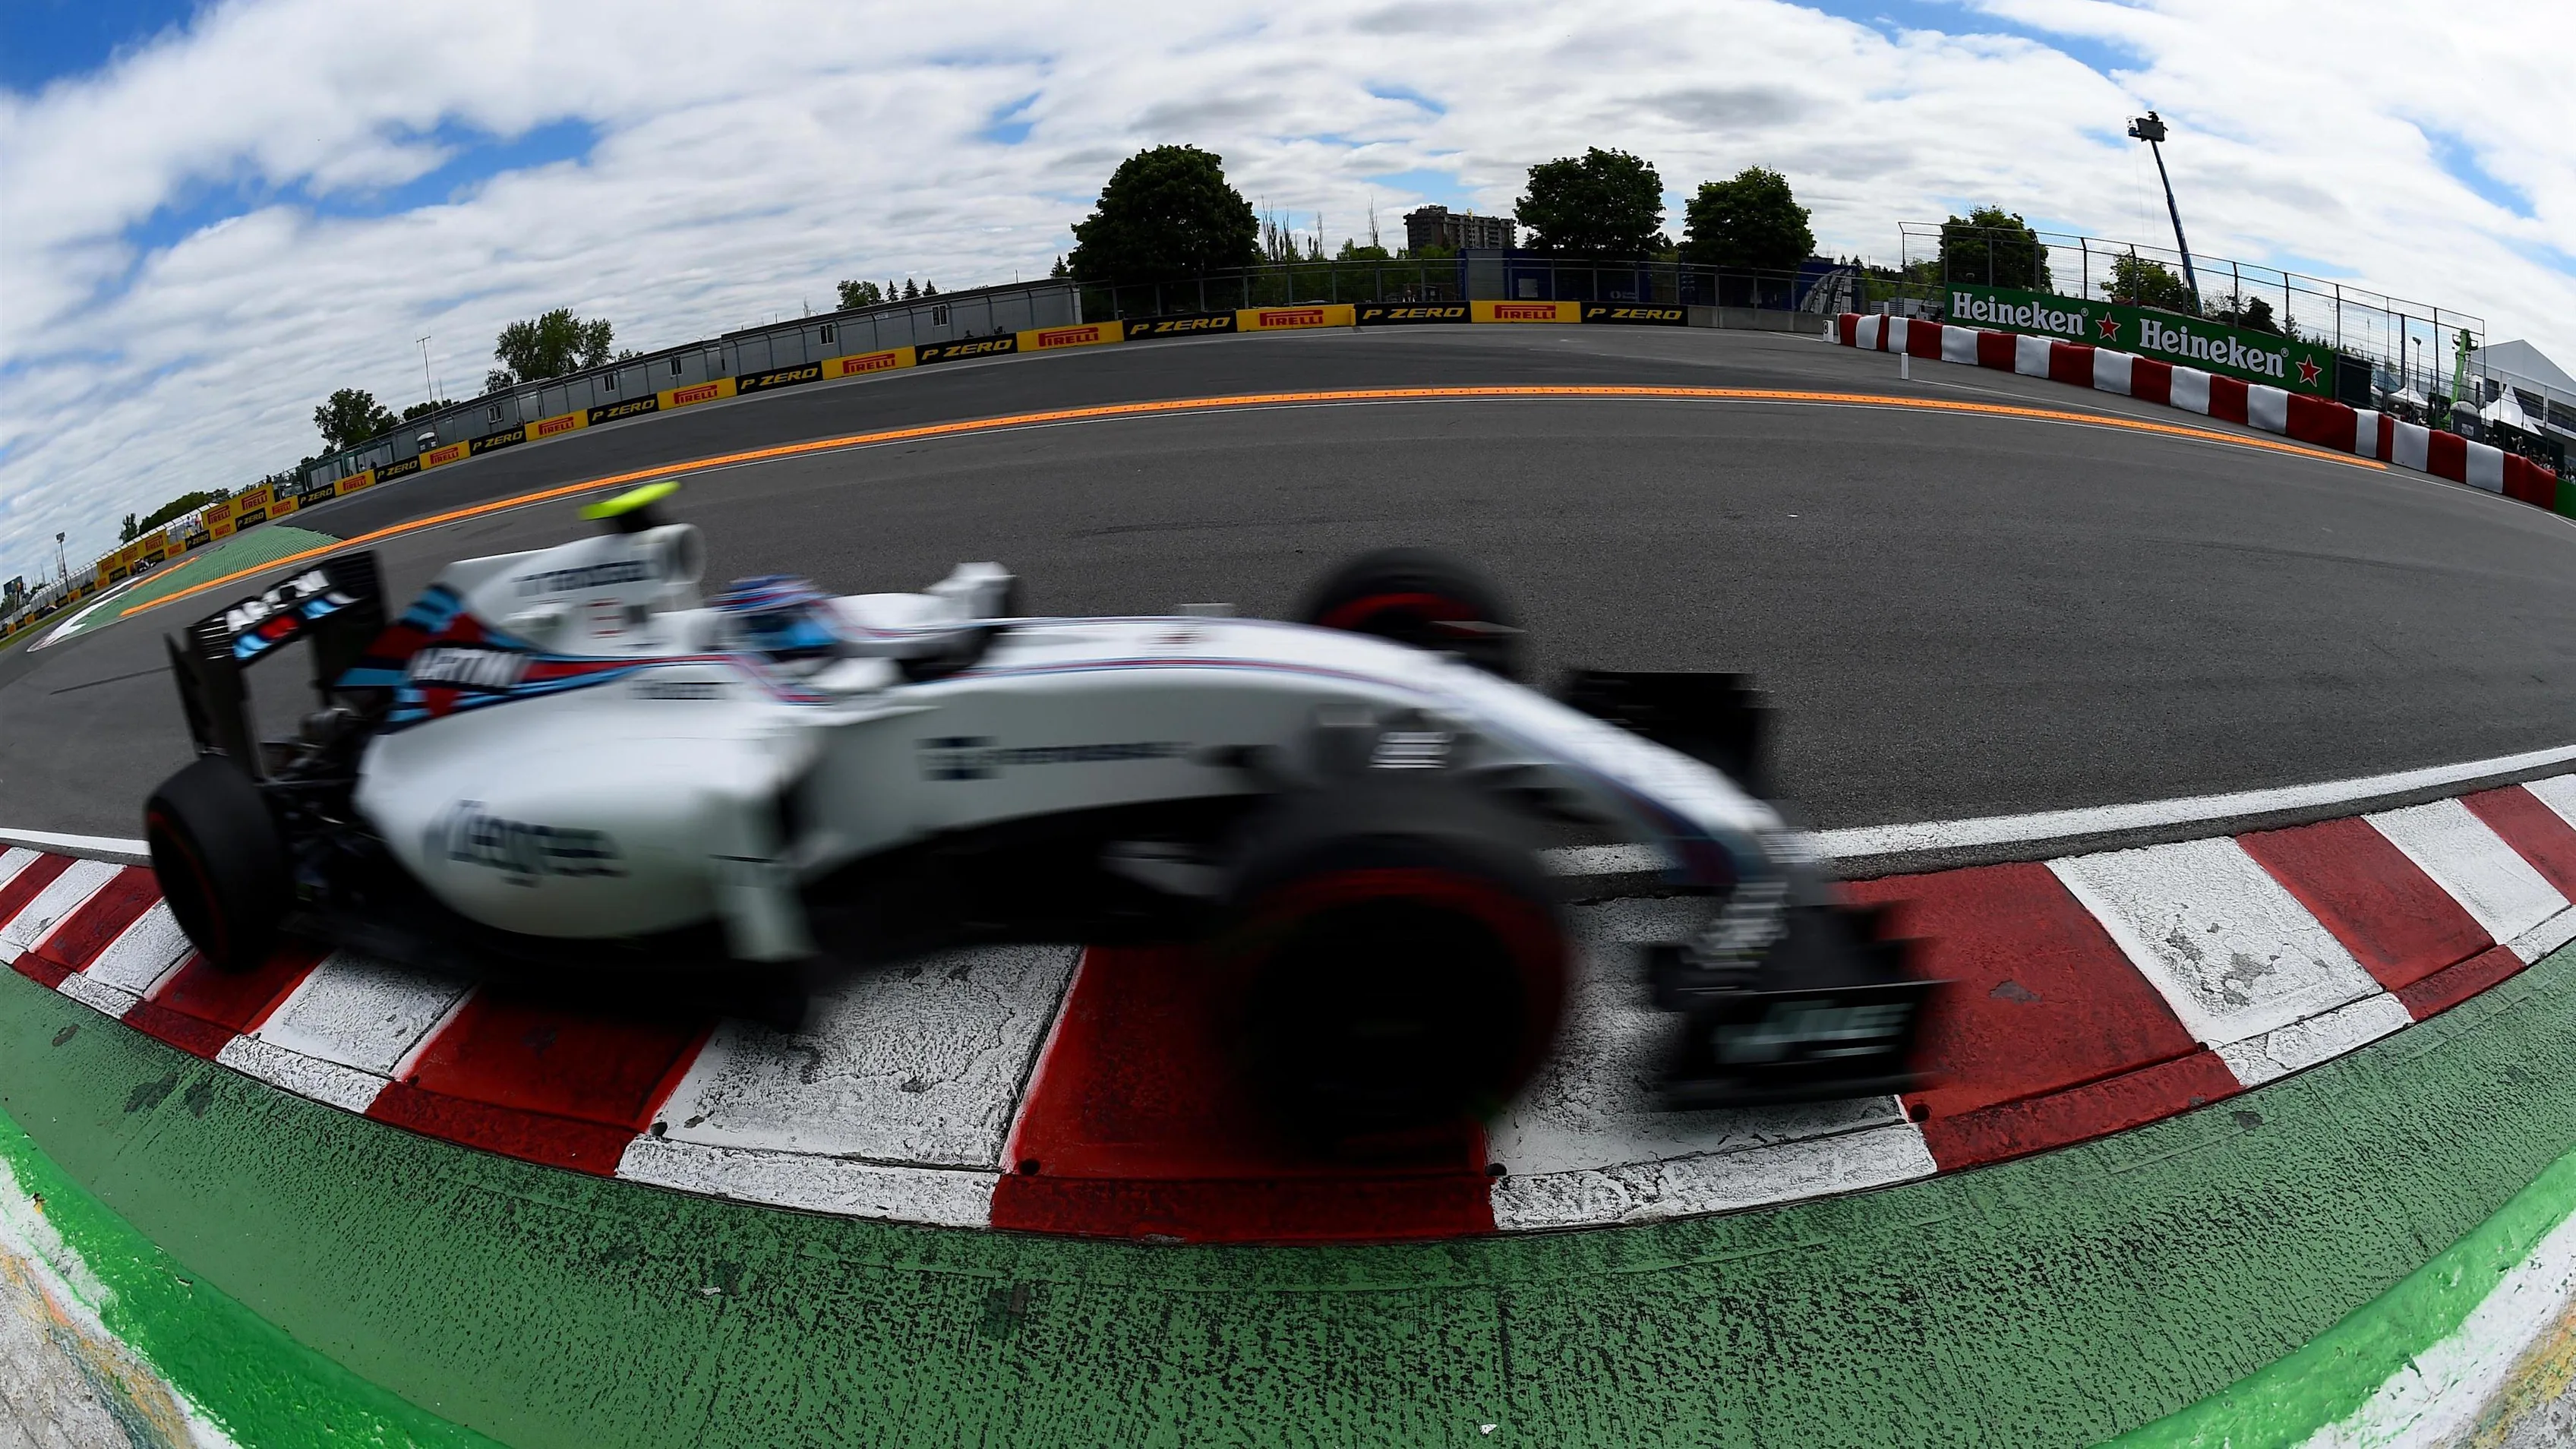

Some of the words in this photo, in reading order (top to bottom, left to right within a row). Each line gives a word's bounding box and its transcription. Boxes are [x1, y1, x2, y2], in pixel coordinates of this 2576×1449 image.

[1259, 309, 1324, 327] PIRELLI
[1362, 309, 1383, 320] P
[1387, 307, 1465, 319] ZERO
[1494, 305, 1556, 320] PIRELLI
[1586, 308, 1606, 317] P
[1611, 308, 1683, 320] ZERO
[1952, 292, 2085, 336] Heineken
[1130, 324, 1151, 335] P
[1154, 317, 1231, 333] ZERO
[1038, 327, 1099, 347] PIRELLI
[922, 349, 939, 361] P
[943, 339, 1012, 356] ZERO
[2139, 318, 2284, 377] Heineken
[843, 353, 895, 374] PIRELLI
[740, 378, 755, 390] P
[759, 368, 819, 387] ZERO
[674, 384, 718, 406] PIRELLI
[592, 411, 604, 421] P
[607, 399, 655, 417] ZERO
[538, 416, 574, 435] PIRELLI
[472, 441, 482, 451] P
[485, 431, 522, 448] ZERO
[430, 447, 459, 465] PIRELLI
[377, 470, 386, 479] P
[387, 460, 418, 476] ZERO
[343, 475, 366, 491] PIRELLI
[242, 490, 267, 510] PIRELLI
[308, 488, 333, 502] ZERO
[207, 505, 231, 525] PIRELLI
[244, 512, 264, 524] ZERO
